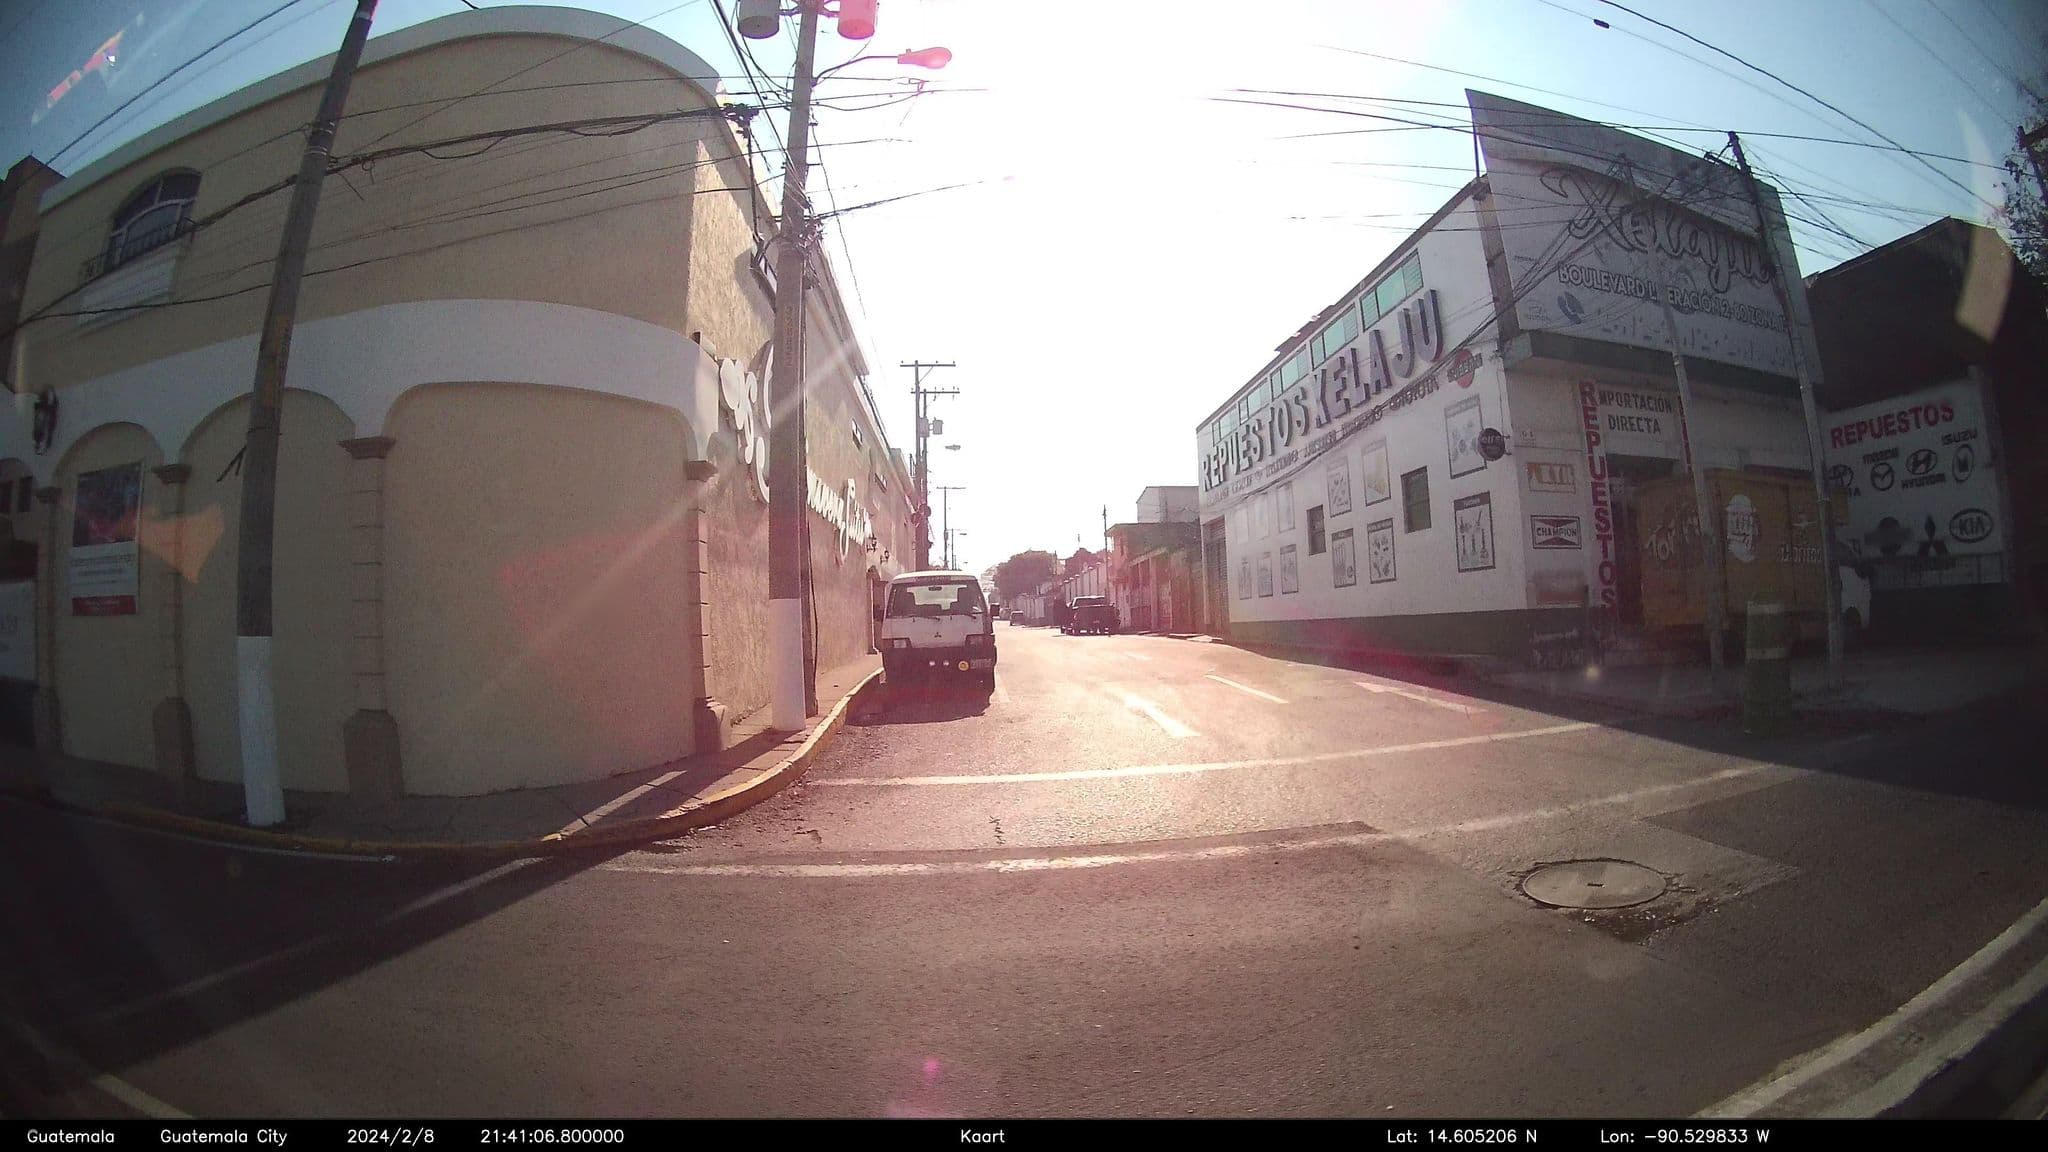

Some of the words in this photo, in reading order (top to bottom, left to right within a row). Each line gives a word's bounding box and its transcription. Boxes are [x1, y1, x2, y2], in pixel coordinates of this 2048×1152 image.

[1558, 262, 1645, 298] BOULEVARD
[1201, 387, 1309, 492] REPUESTOS
[1313, 289, 1444, 429] XELAJU
[1599, 391, 1673, 415] MPORTACIÓN
[1608, 414, 1661, 434] DIRECTA
[1830, 401, 1955, 449] REPUESTOS
[1941, 428, 1978, 446] ISUZU
[1579, 380, 1618, 614] REPUESTOS
[1536, 526, 1577, 538] CHAMPION
[1959, 516, 1985, 536] KIA
